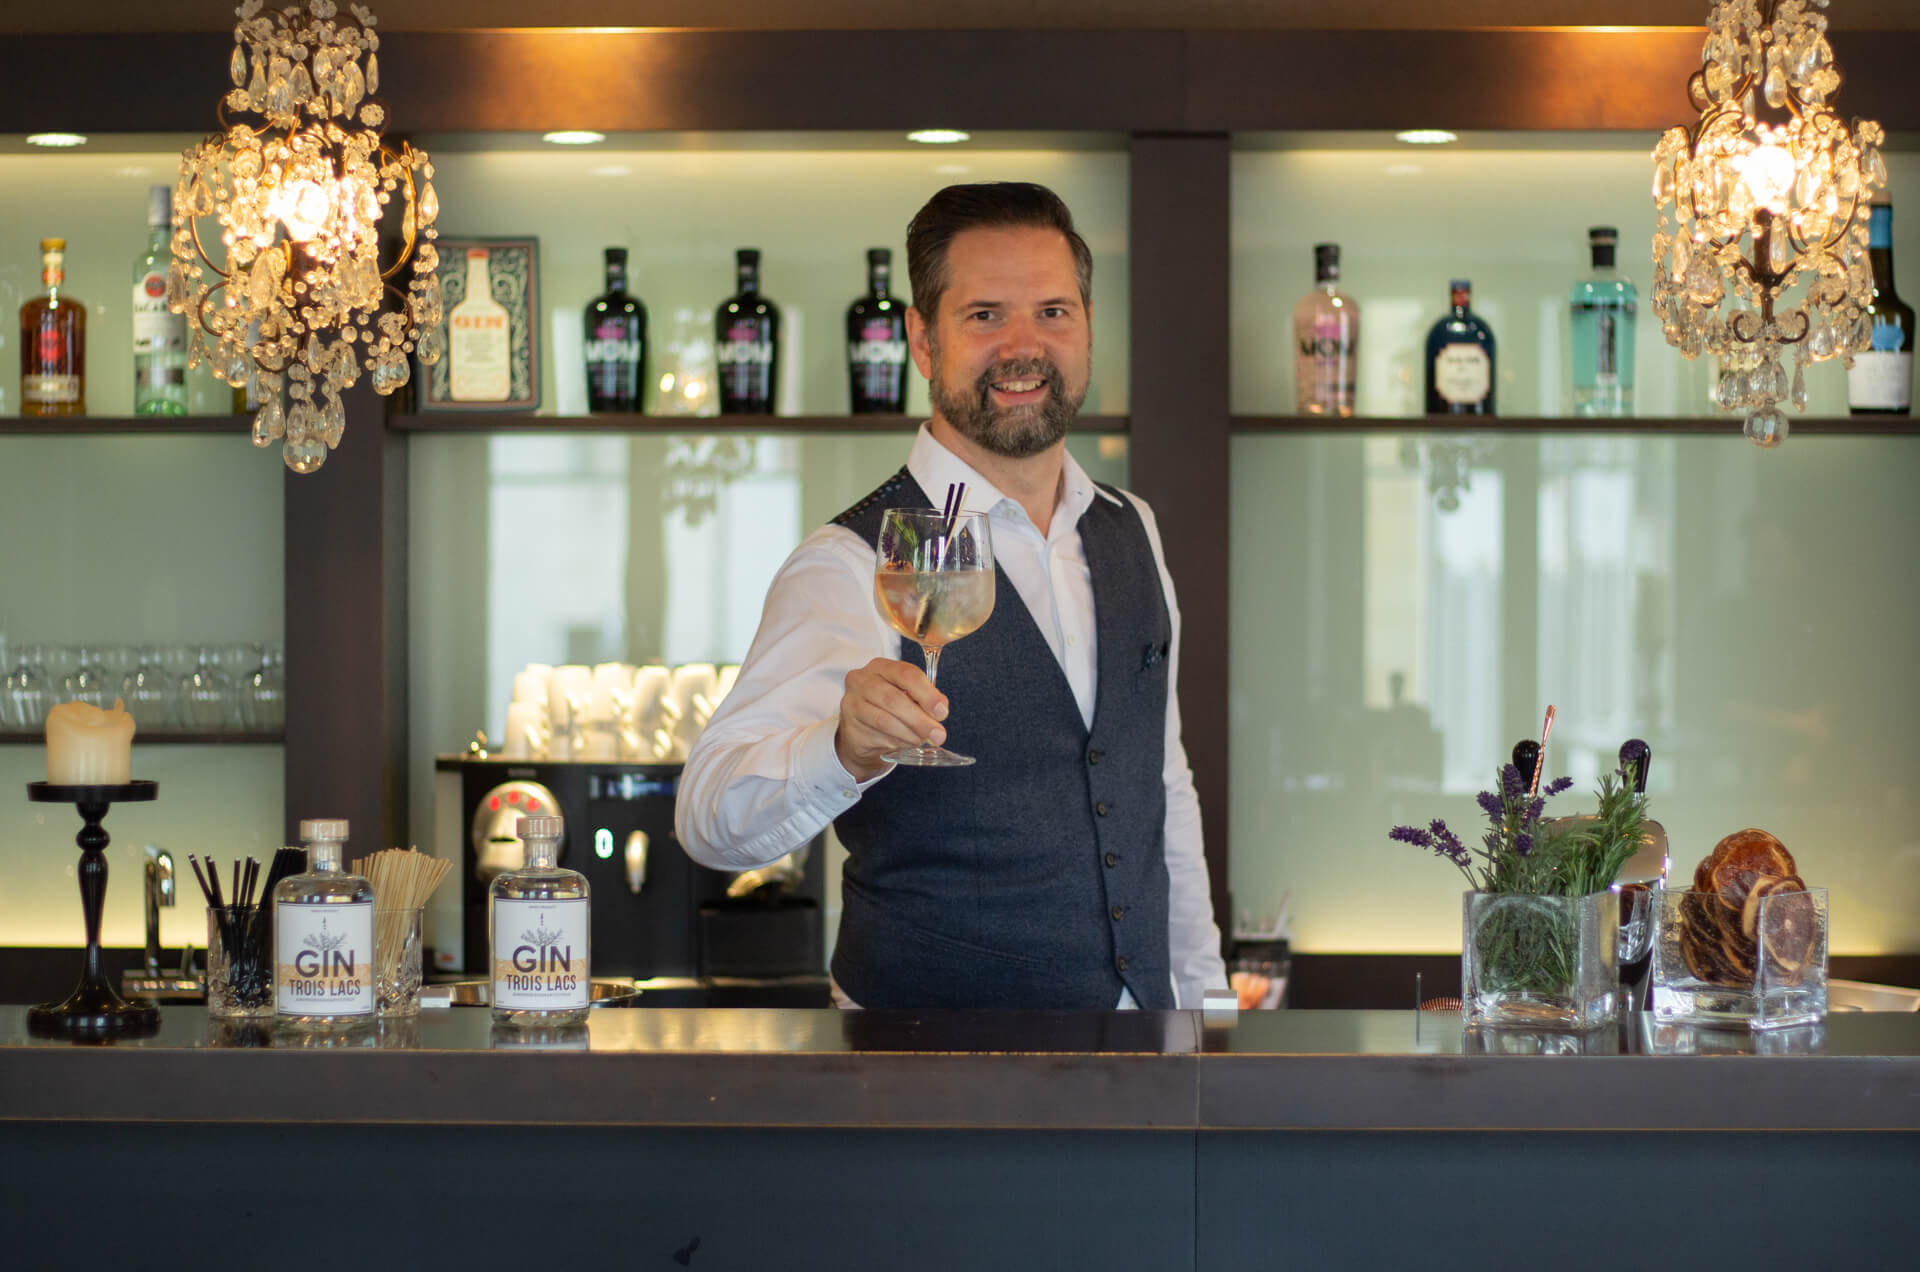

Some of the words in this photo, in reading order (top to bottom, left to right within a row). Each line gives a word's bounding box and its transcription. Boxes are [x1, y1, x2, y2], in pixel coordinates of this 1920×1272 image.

[295, 949, 354, 978] GIN
[512, 945, 571, 973] GIN
[289, 979, 325, 996] TROIS
[331, 979, 361, 996] LACS
[506, 974, 542, 991] TROIS
[547, 974, 576, 991] LACS
